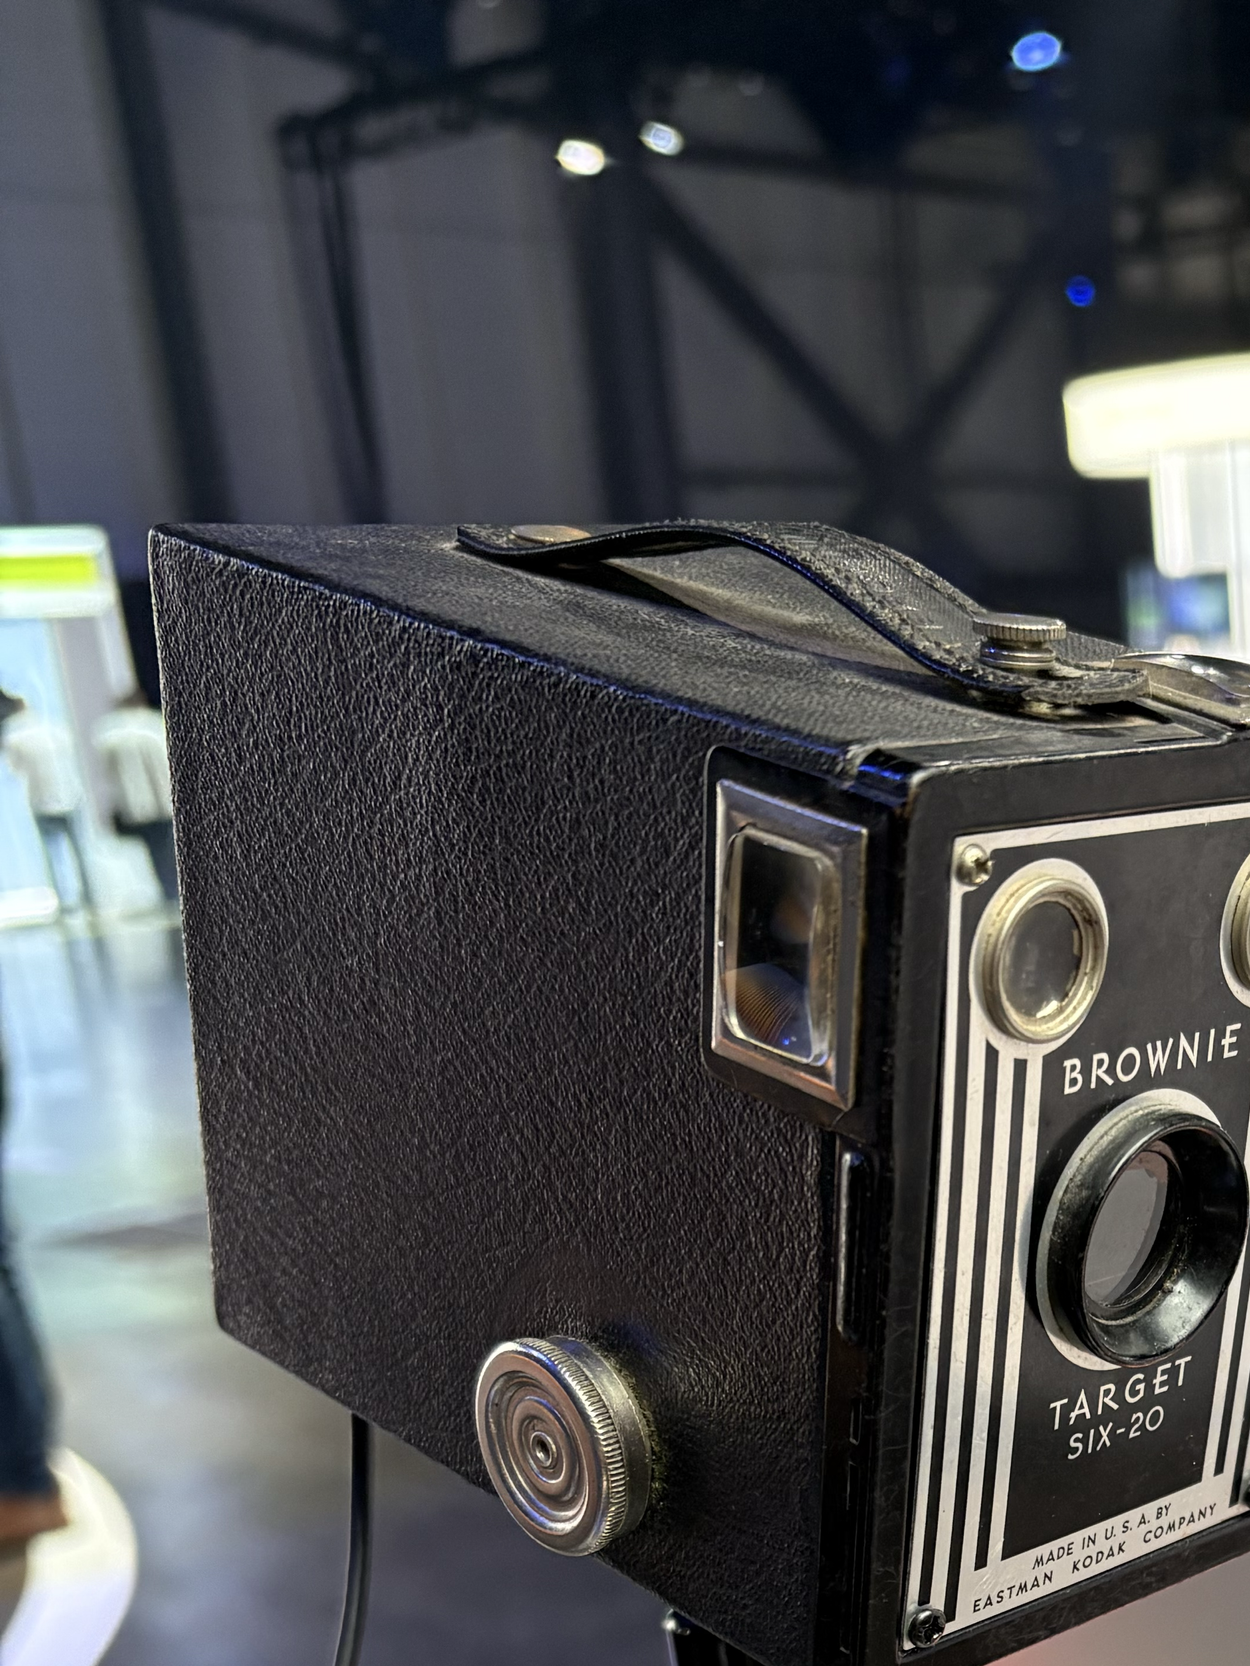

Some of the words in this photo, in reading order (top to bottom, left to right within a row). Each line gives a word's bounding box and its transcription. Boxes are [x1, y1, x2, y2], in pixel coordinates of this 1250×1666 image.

[1063, 1022, 1242, 1095] BROWNIE
[1049, 1355, 1192, 1431] TARGET
[1067, 1405, 1165, 1460] SIX-20
[972, 1570, 1054, 1613] EASTMAN
[1071, 1541, 1126, 1575] KODAK
[1143, 1503, 1217, 1544] COMPANY
[1032, 1541, 1075, 1571] MADE
[1081, 1532, 1097, 1551] IN
[1155, 1503, 1172, 1520] BY
